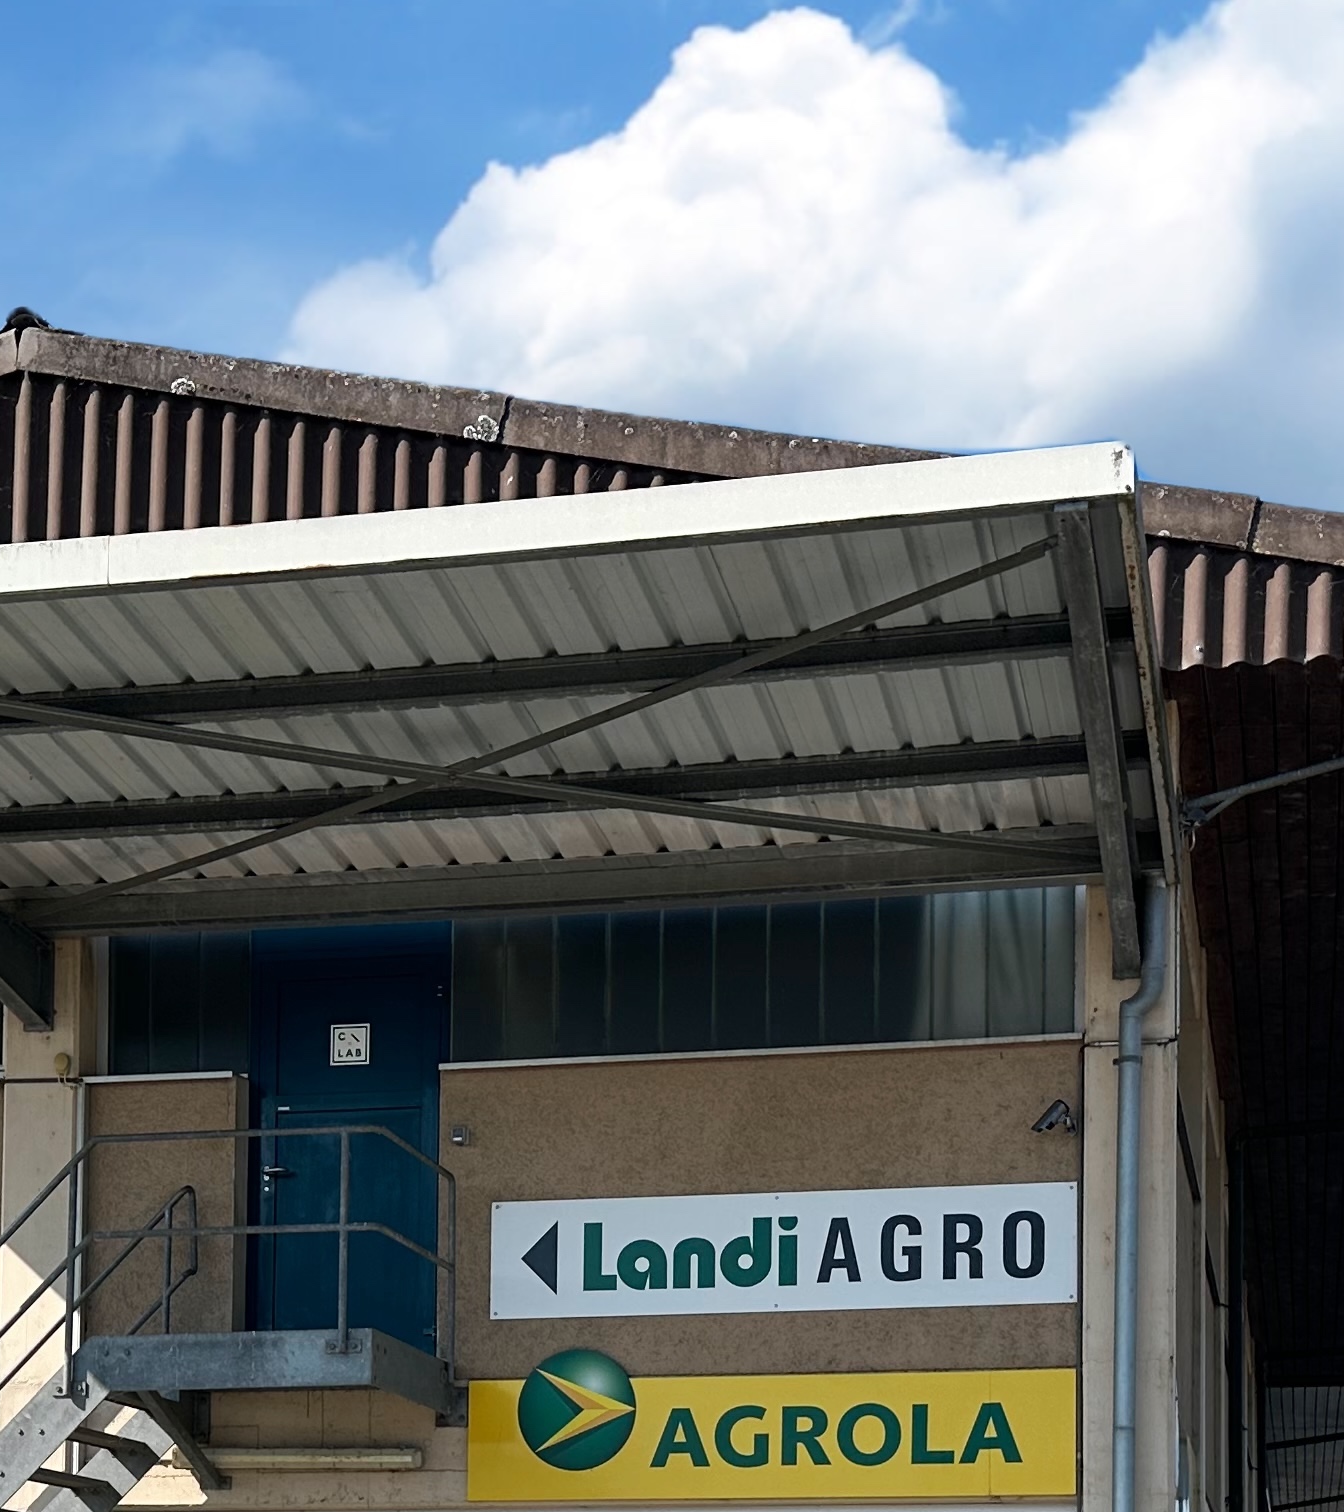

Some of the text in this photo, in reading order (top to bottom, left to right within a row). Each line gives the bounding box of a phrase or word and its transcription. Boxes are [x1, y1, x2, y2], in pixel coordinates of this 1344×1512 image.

[338, 1048, 362, 1058] LAB
[583, 1210, 1046, 1292] Landi AGRO
[650, 1402, 1024, 1468] AGROLA
